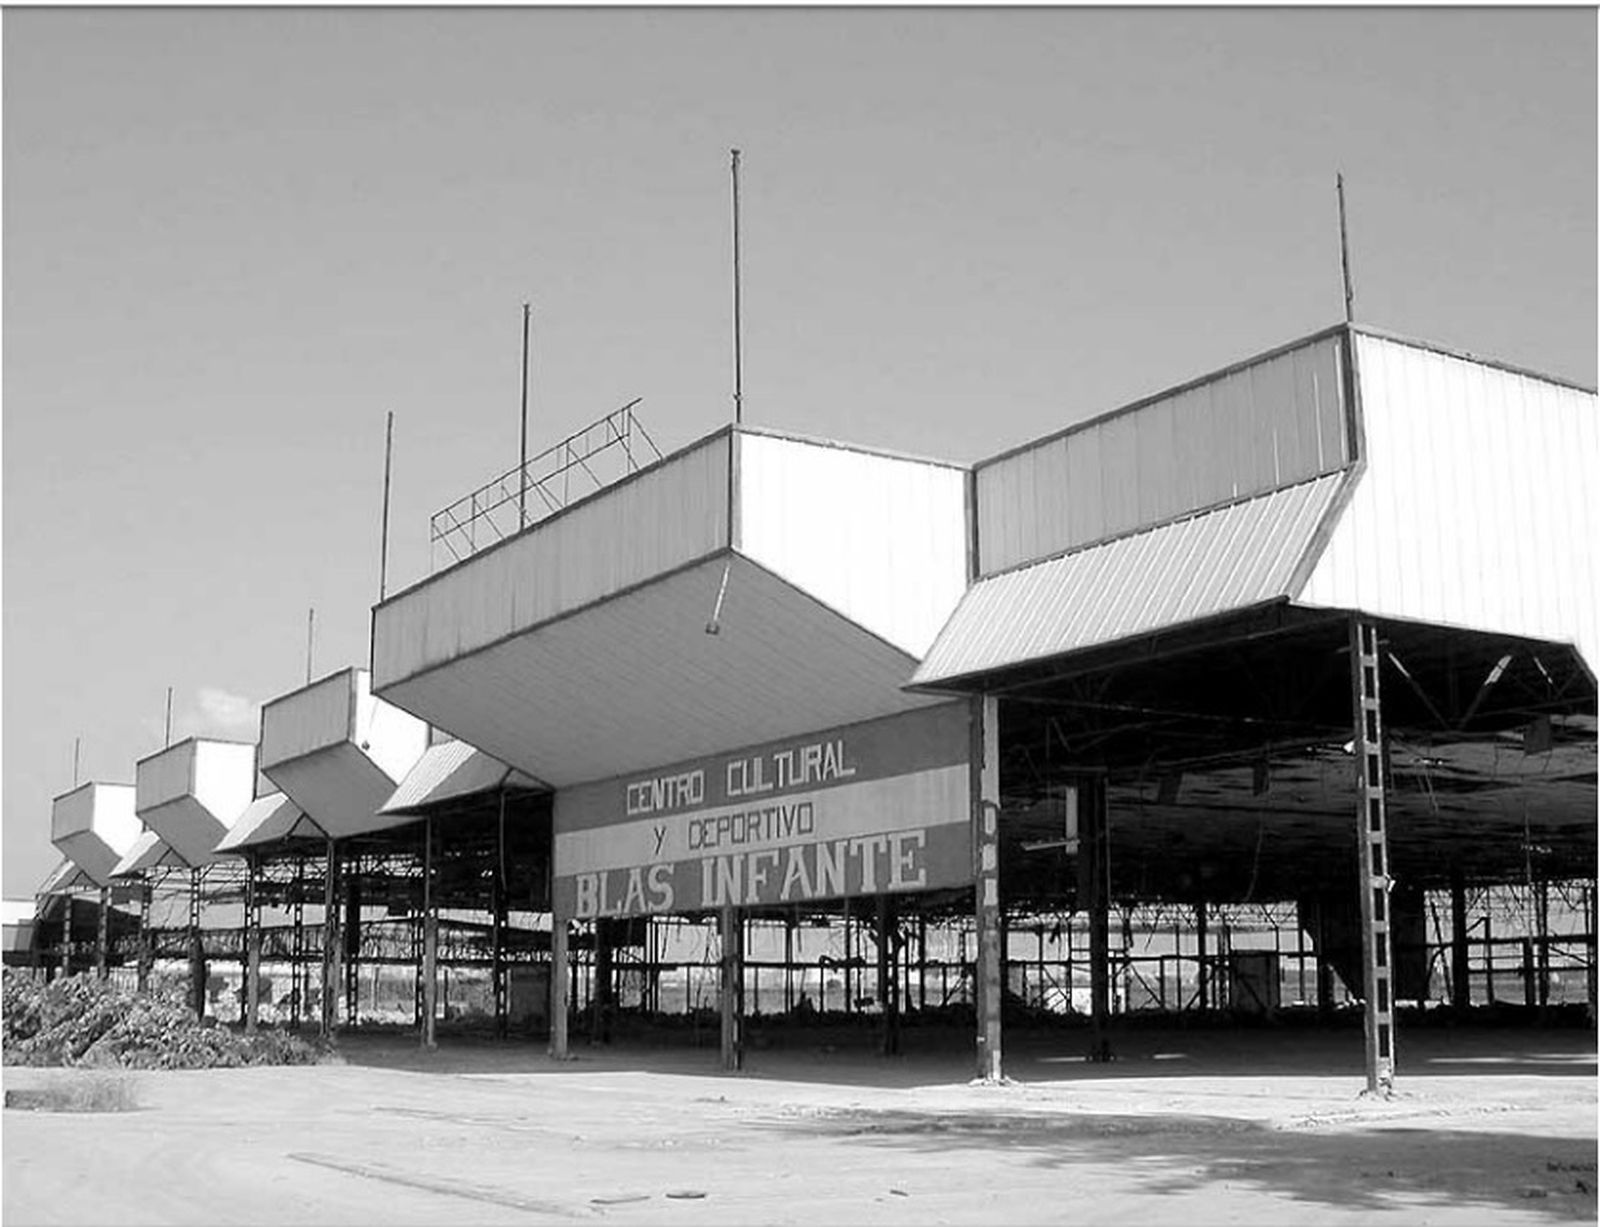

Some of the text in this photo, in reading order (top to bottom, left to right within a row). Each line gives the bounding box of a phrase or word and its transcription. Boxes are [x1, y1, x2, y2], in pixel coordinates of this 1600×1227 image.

[627, 740, 856, 815] CENTRO CULTURAL
[689, 802, 814, 850] DEPORTIVO
[575, 830, 927, 919] BLAS INFANTE
